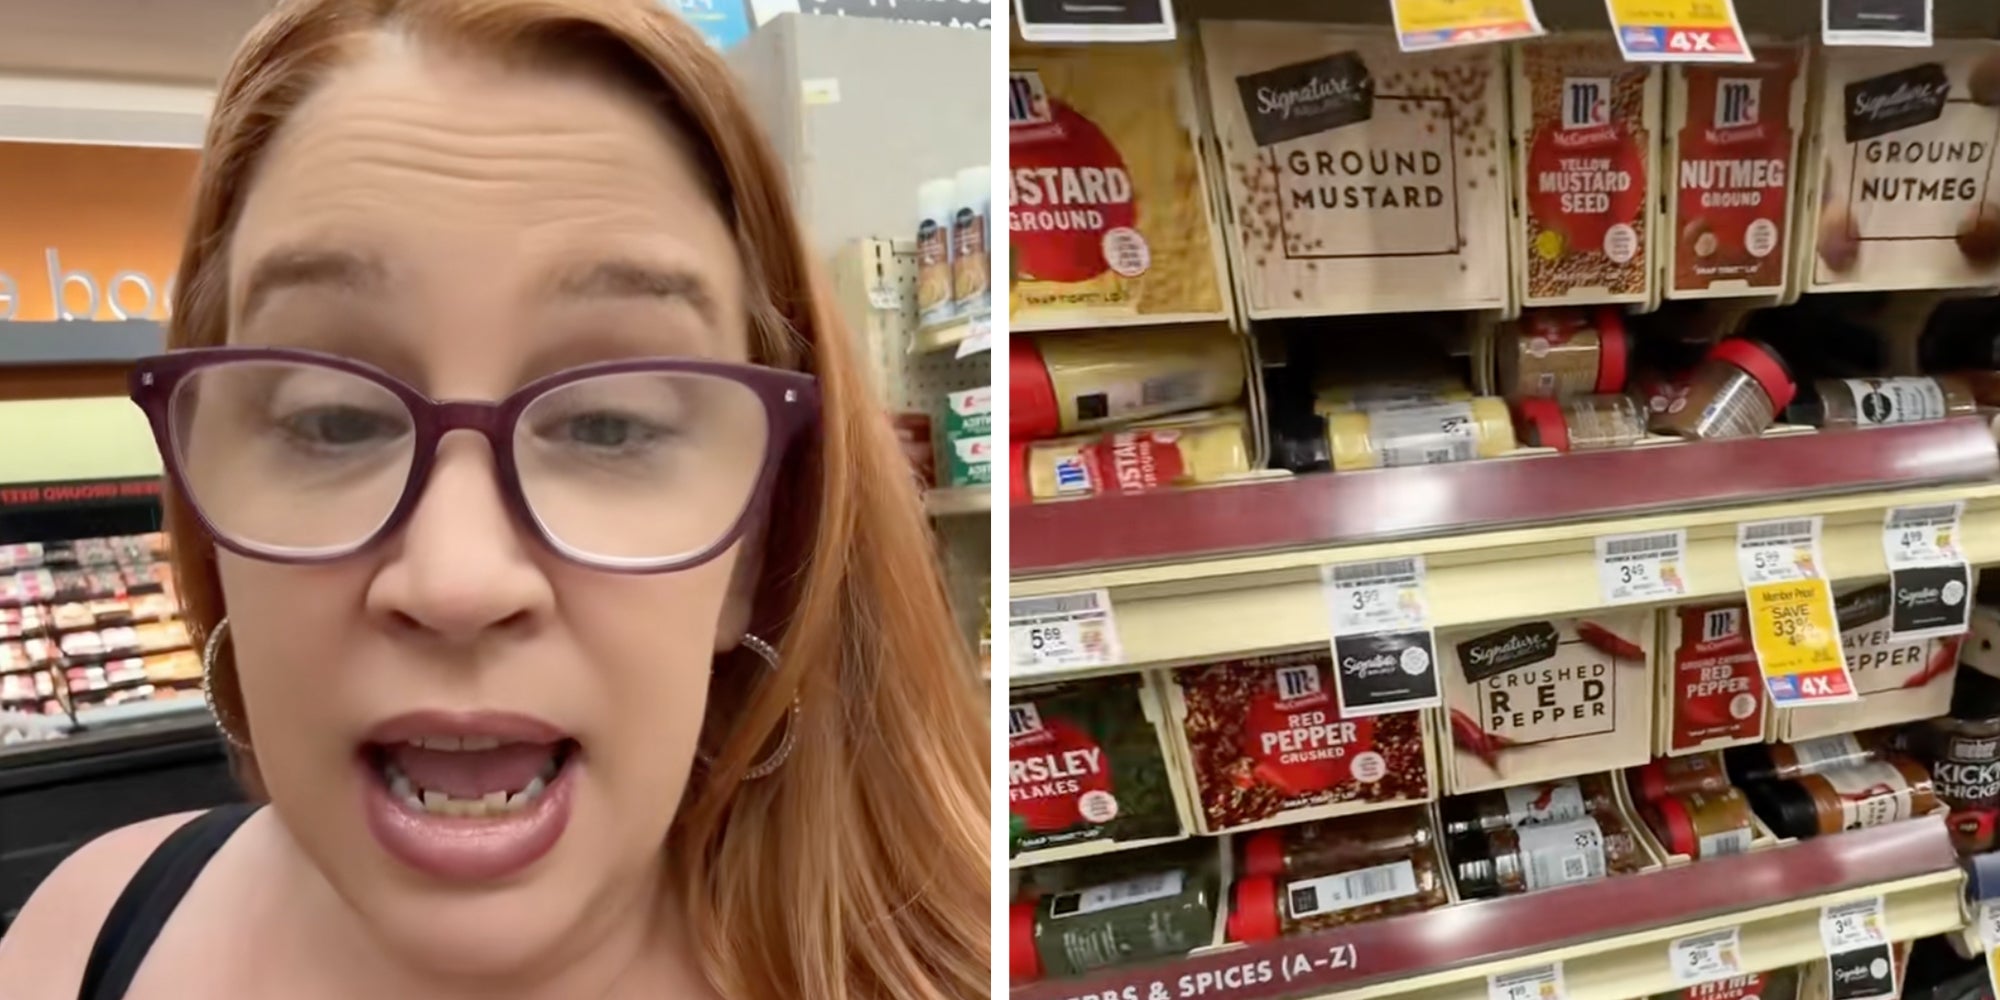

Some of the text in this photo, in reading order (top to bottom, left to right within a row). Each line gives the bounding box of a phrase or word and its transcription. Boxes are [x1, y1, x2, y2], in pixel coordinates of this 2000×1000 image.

[1670, 32, 1716, 50] 4X
[1257, 77, 1349, 119] Signature
[1866, 141, 1985, 163] GROUND
[1288, 151, 1441, 176] GROUND
[1560, 159, 1611, 171] YELLOW
[1539, 172, 1631, 193] MUSTARD
[1681, 160, 1784, 189] NUTMEG
[1292, 187, 1443, 208] MUSTARD
[1701, 192, 1761, 207] GROUND
[1861, 178, 1976, 201] NUTMEG
[1561, 194, 1609, 213] SEED
[1010, 210, 1103, 230] GROUND
[1772, 604, 1810, 619] SAVE
[1469, 633, 1542, 665] Signature
[1489, 664, 1605, 689] CRUSHED
[1701, 665, 1733, 682] RED
[1687, 677, 1749, 698] PEPPER
[1802, 676, 1834, 696] 4X
[1489, 680, 1604, 714] RED
[1288, 711, 1325, 728] RED
[1492, 702, 1605, 731] PEPPER
[1261, 722, 1357, 754] PEPPER
[1280, 747, 1345, 765] CRUSHED
[1010, 780, 1079, 802] FLAKES
[1179, 960, 1272, 998] SPICES
